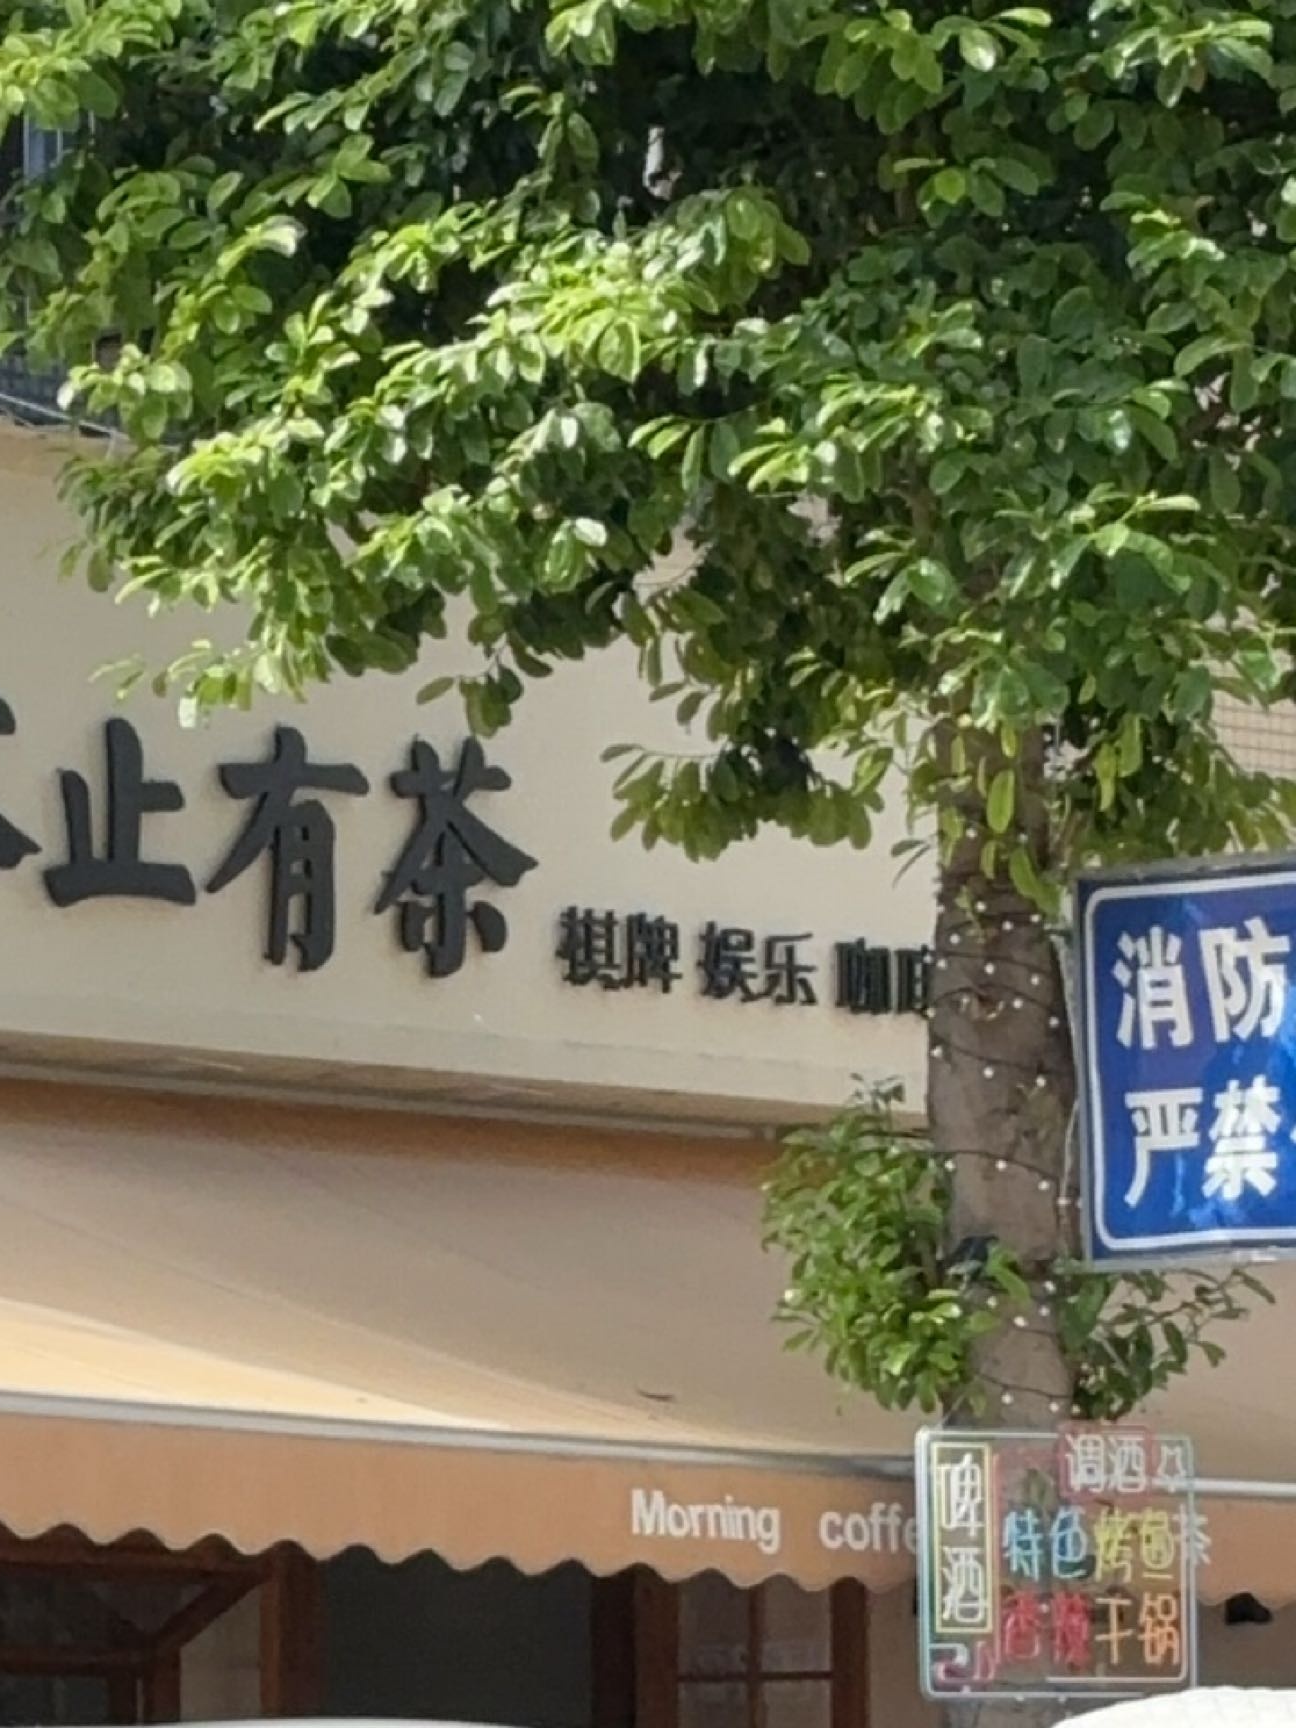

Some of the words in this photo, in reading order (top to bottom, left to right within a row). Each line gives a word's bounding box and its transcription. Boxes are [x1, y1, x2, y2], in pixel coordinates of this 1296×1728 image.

[556, 906, 683, 994] 棋牌
[697, 920, 818, 1006] 娱乐
[1112, 916, 1290, 1050] 消防
[1123, 1074, 1296, 1208] 严禁
[632, 1488, 781, 1555] Morning
[935, 1453, 986, 1623] 啤酒
